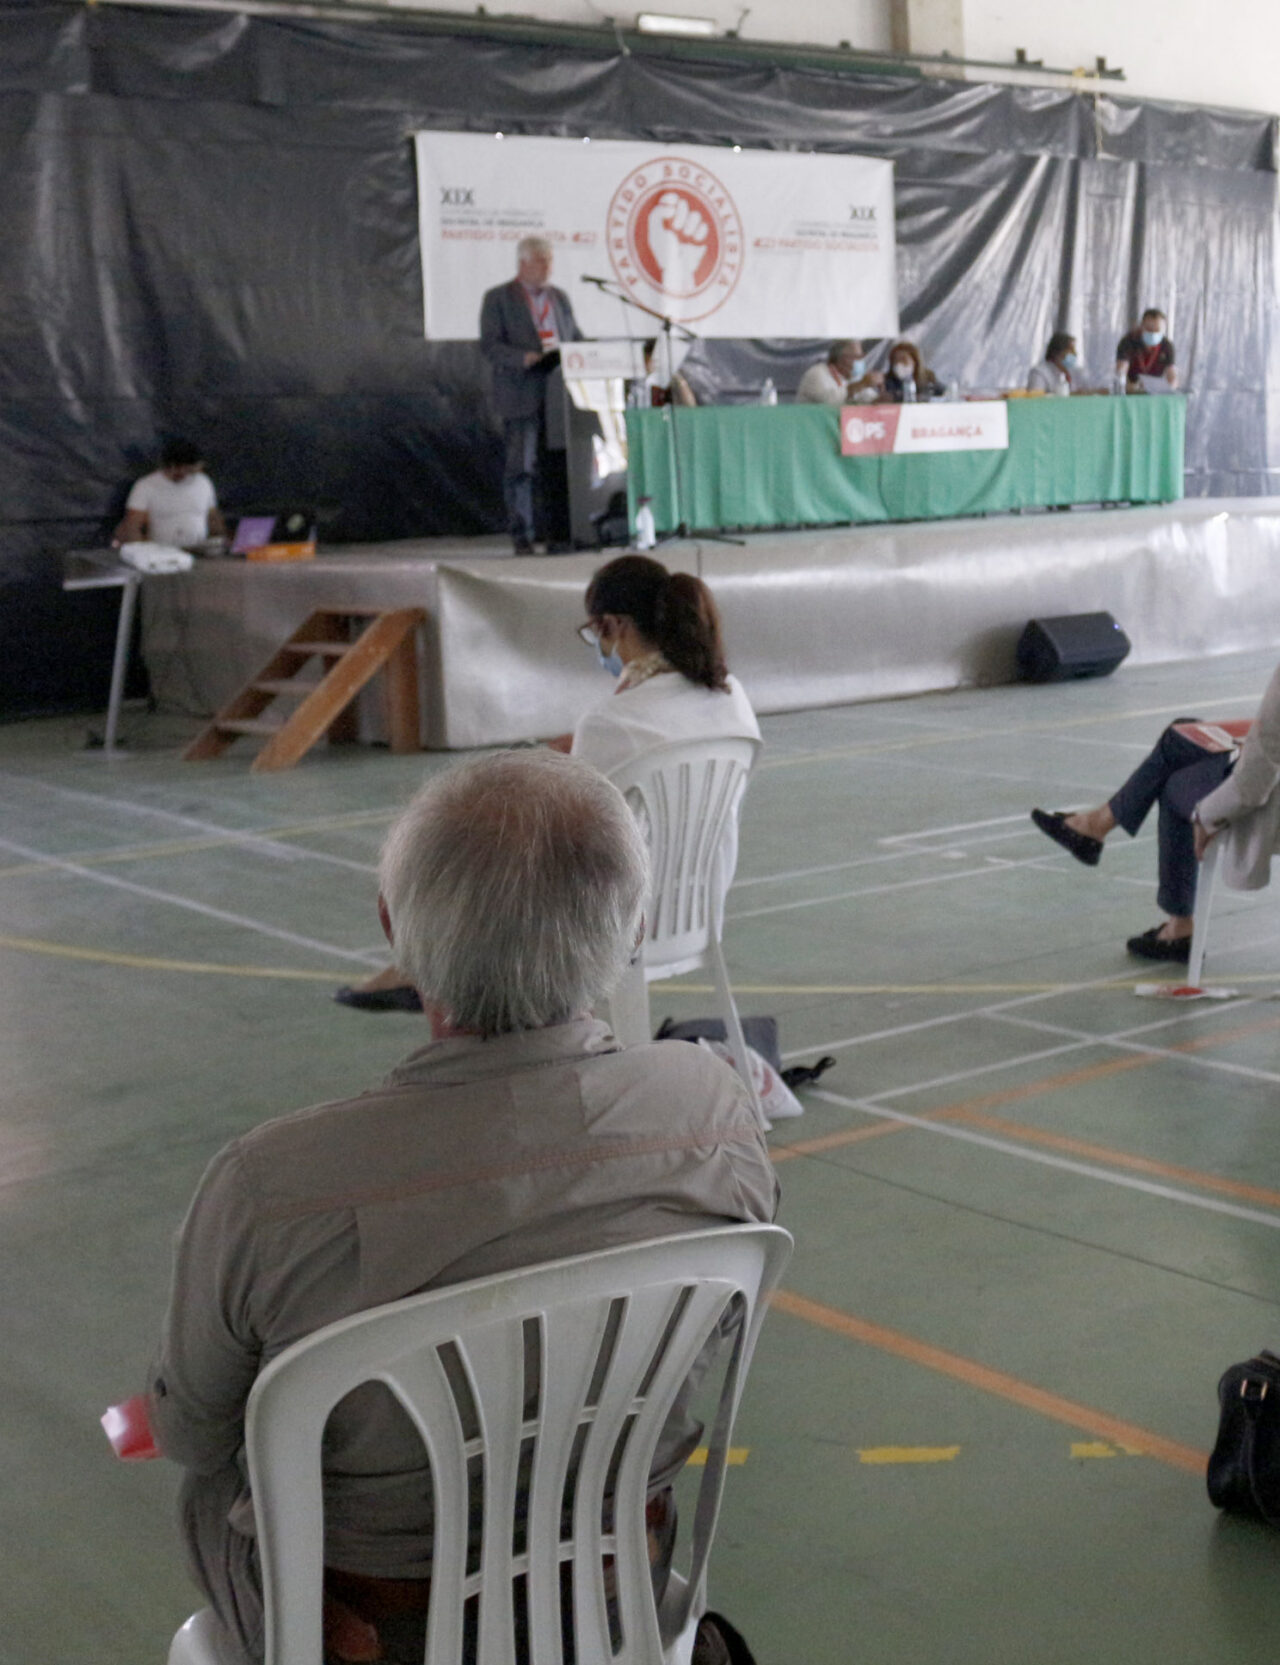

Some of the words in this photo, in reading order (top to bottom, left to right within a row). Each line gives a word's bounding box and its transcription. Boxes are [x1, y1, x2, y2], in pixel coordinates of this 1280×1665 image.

[440, 187, 475, 206] XIX
[849, 204, 877, 221] XIX
[612, 174, 647, 286] PARTIDO
[662, 164, 738, 286] SOCIALISTA
[441, 228, 495, 241] PARTIDO
[865, 421, 887, 441] PS
[911, 424, 983, 439] BRAGANÇA
